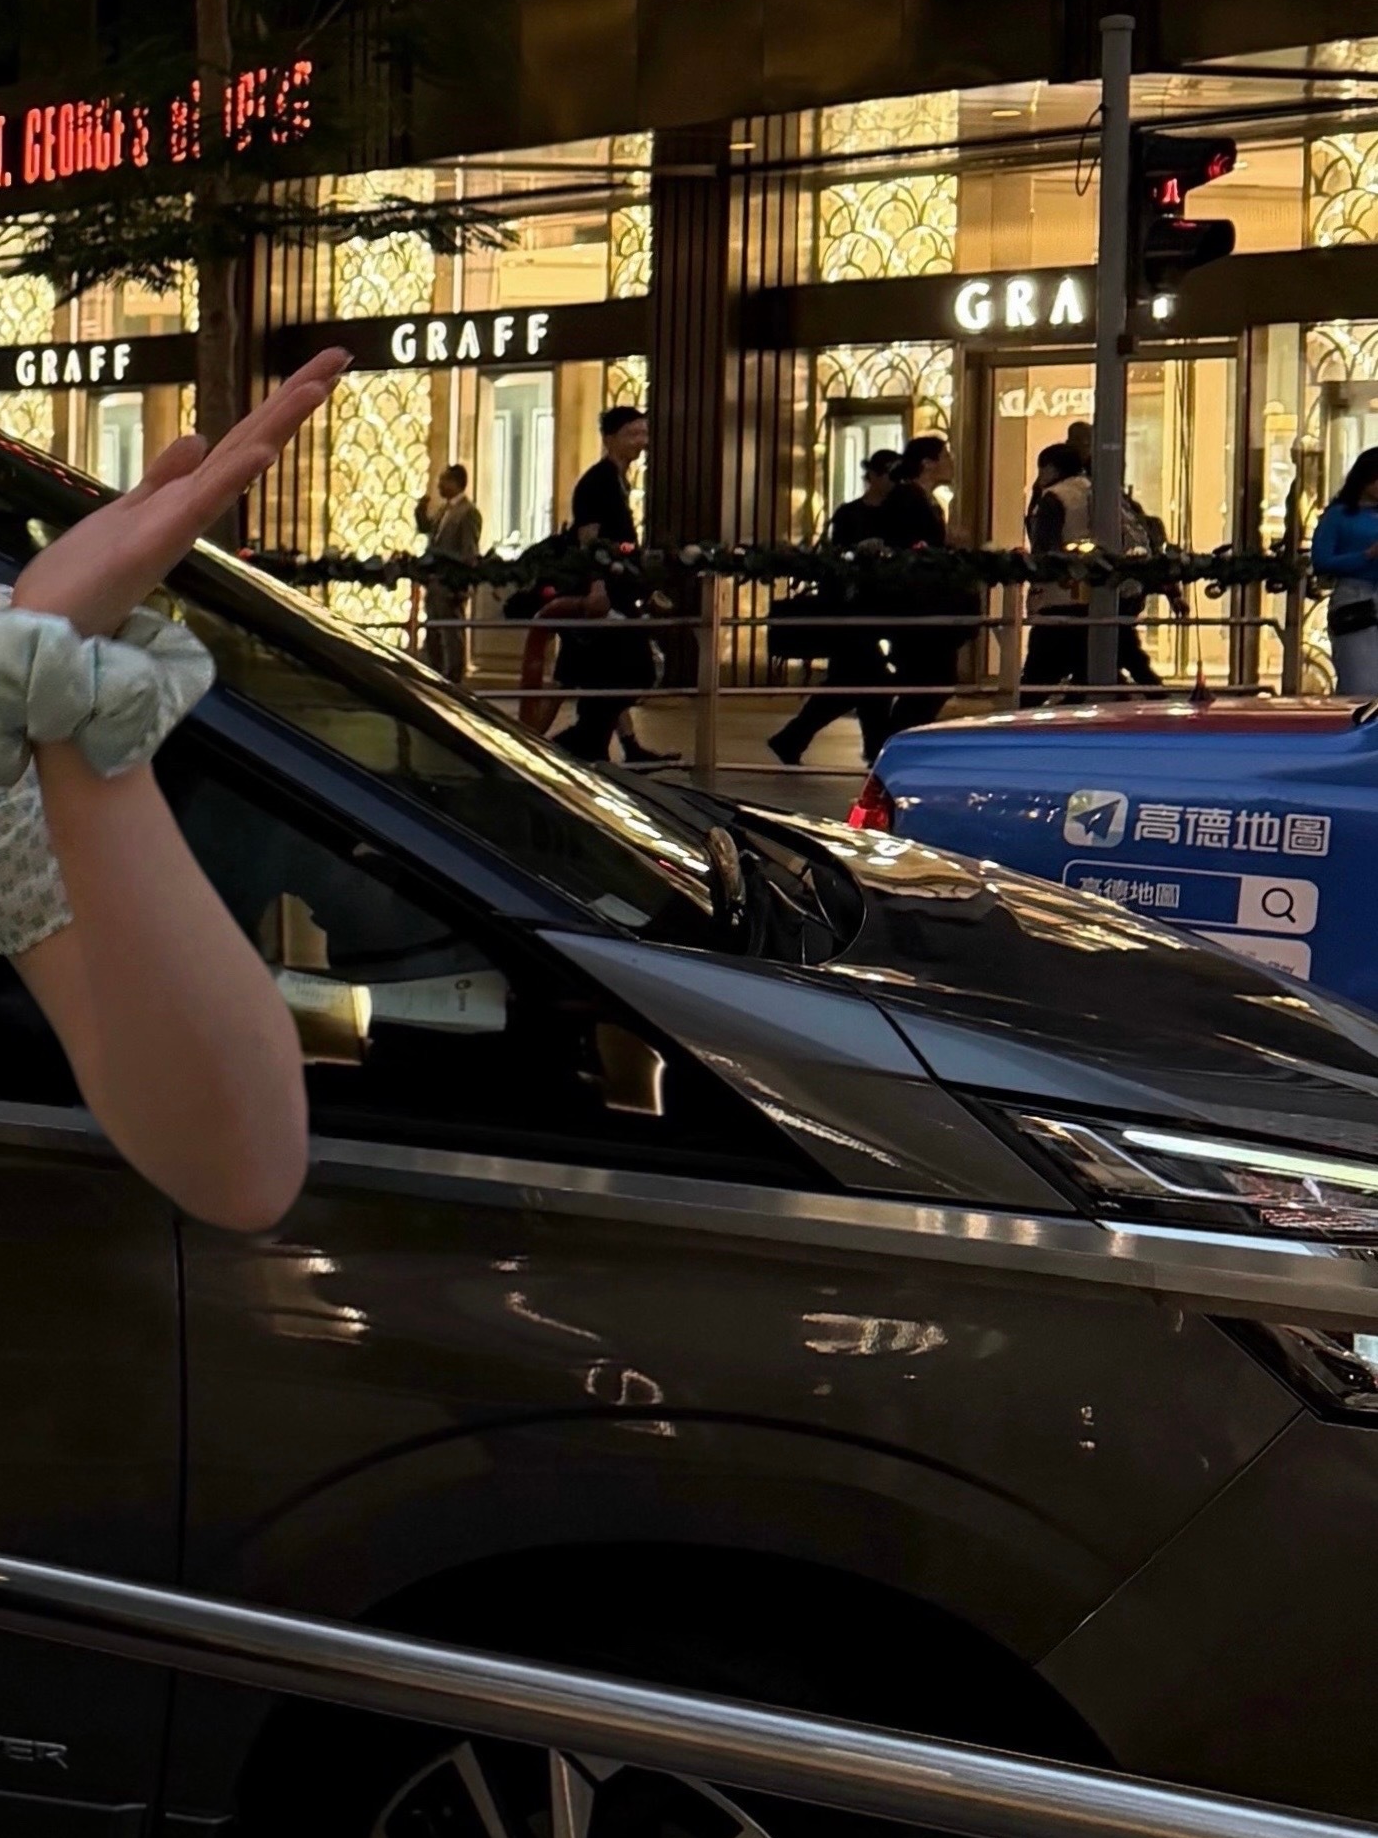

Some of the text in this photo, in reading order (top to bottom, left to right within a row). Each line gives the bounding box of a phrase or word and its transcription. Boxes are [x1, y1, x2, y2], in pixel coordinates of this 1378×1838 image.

[15, 342, 132, 388] GRAFF
[391, 312, 551, 365] GRAFF
[1134, 802, 1332, 858] 高德地圖
